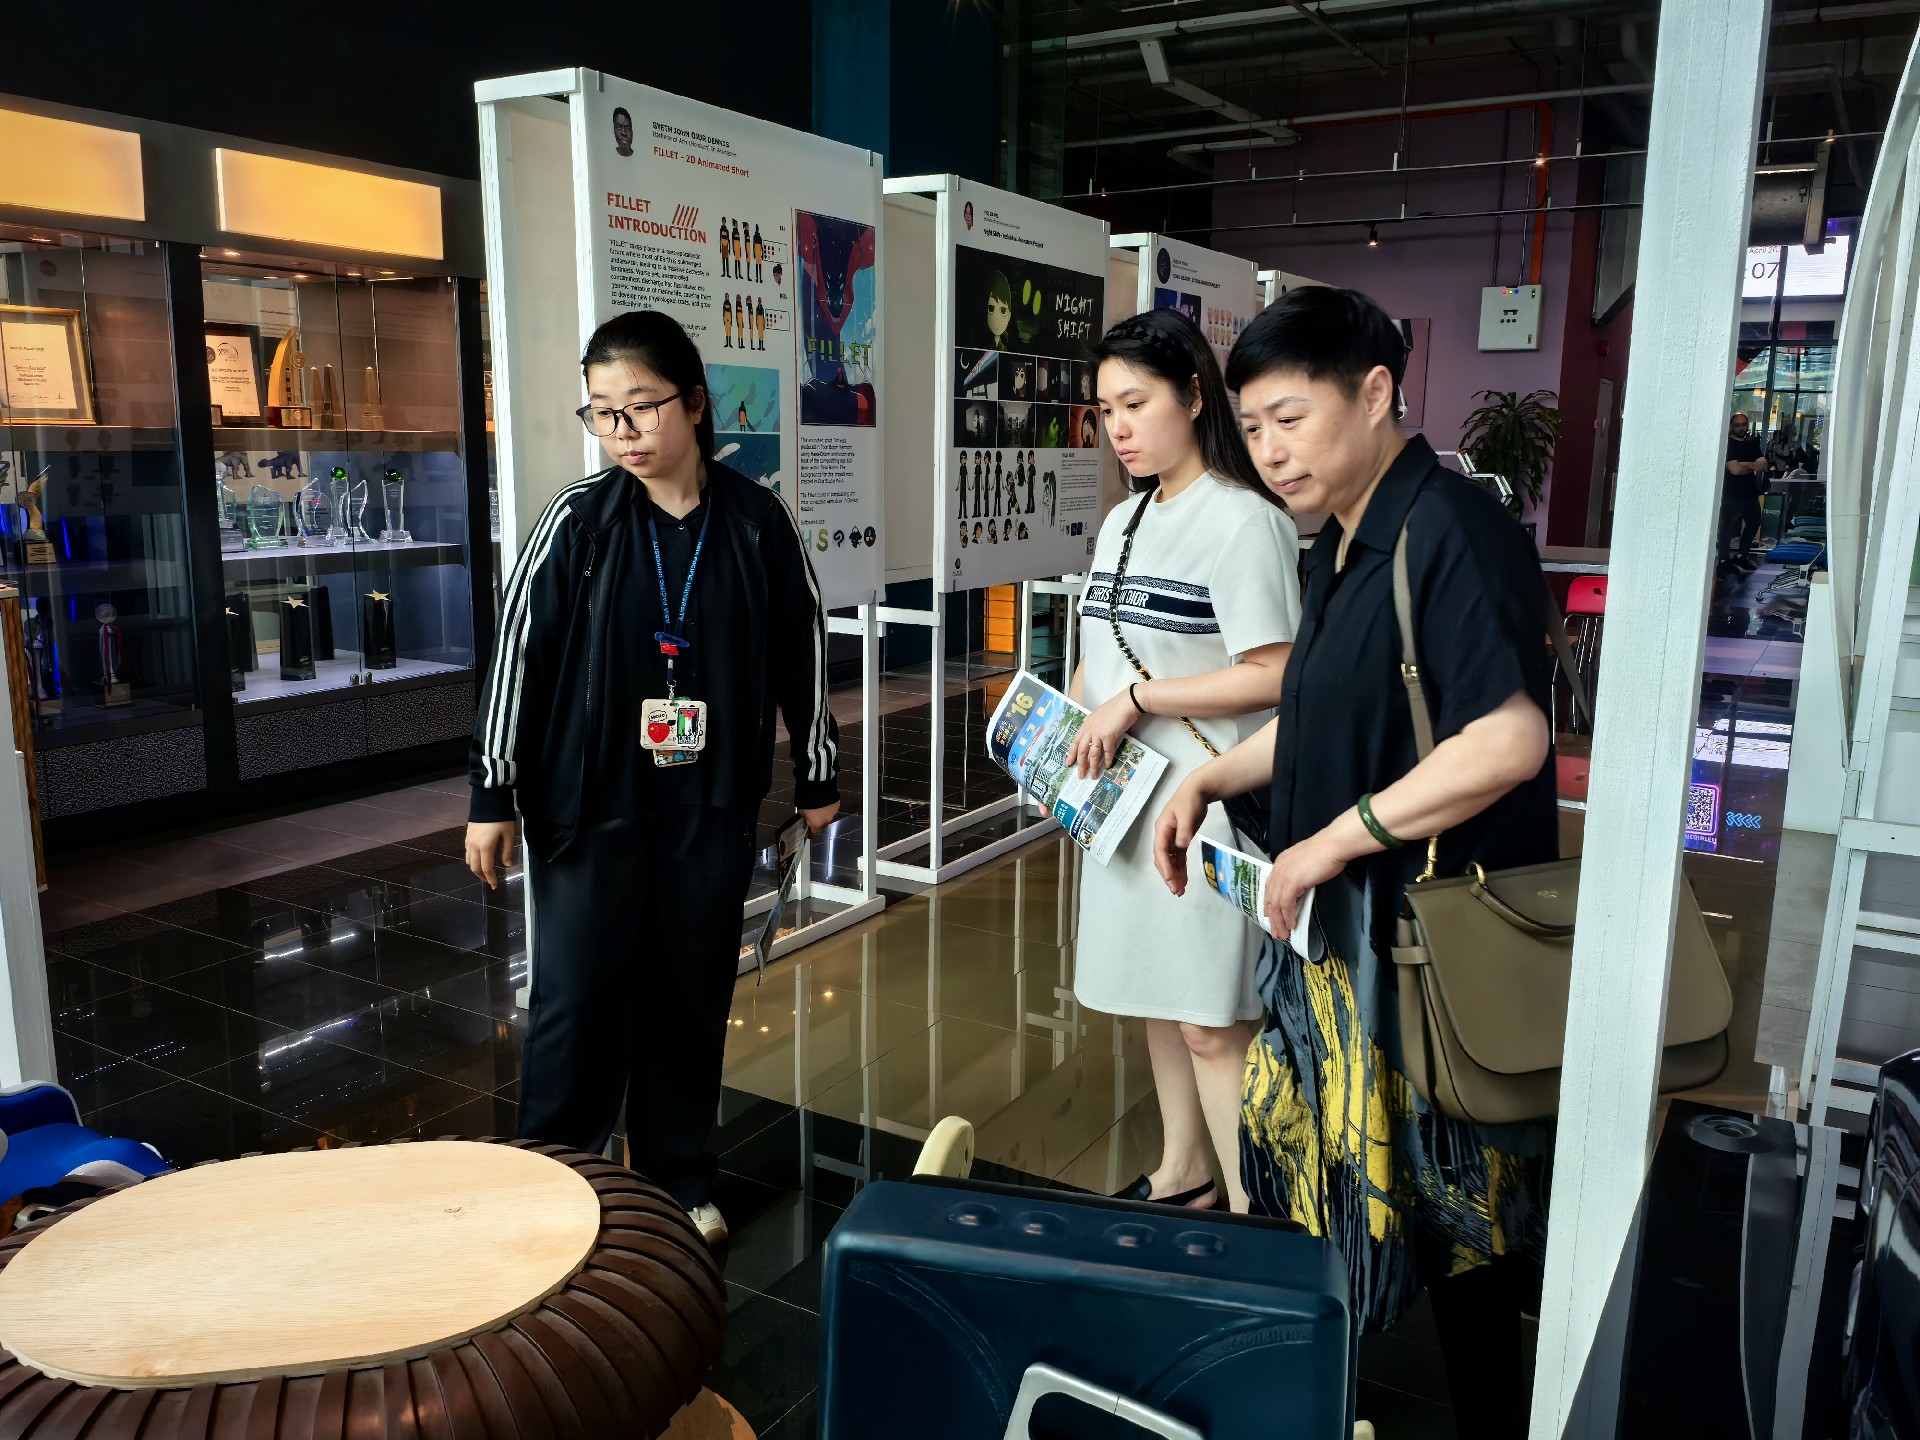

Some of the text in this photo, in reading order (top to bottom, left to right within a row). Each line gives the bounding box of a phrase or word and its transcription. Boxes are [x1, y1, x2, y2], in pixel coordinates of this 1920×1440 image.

[653, 146, 679, 160] FILLET
[686, 154, 696, 164] 2D
[697, 157, 730, 172] Animated
[731, 166, 750, 178] Short
[607, 191, 652, 214] FILLET
[607, 214, 707, 244] INTRODUCTION
[1055, 293, 1095, 317] NIGHT
[1056, 318, 1093, 340] SHIFT
[806, 336, 873, 367] FILLET
[652, 540, 664, 578] UNIVERSITY
[678, 582, 692, 622] UNIVERSITY
[1089, 586, 1150, 608] CHRISN DIOR
[1011, 692, 1034, 716] 16
